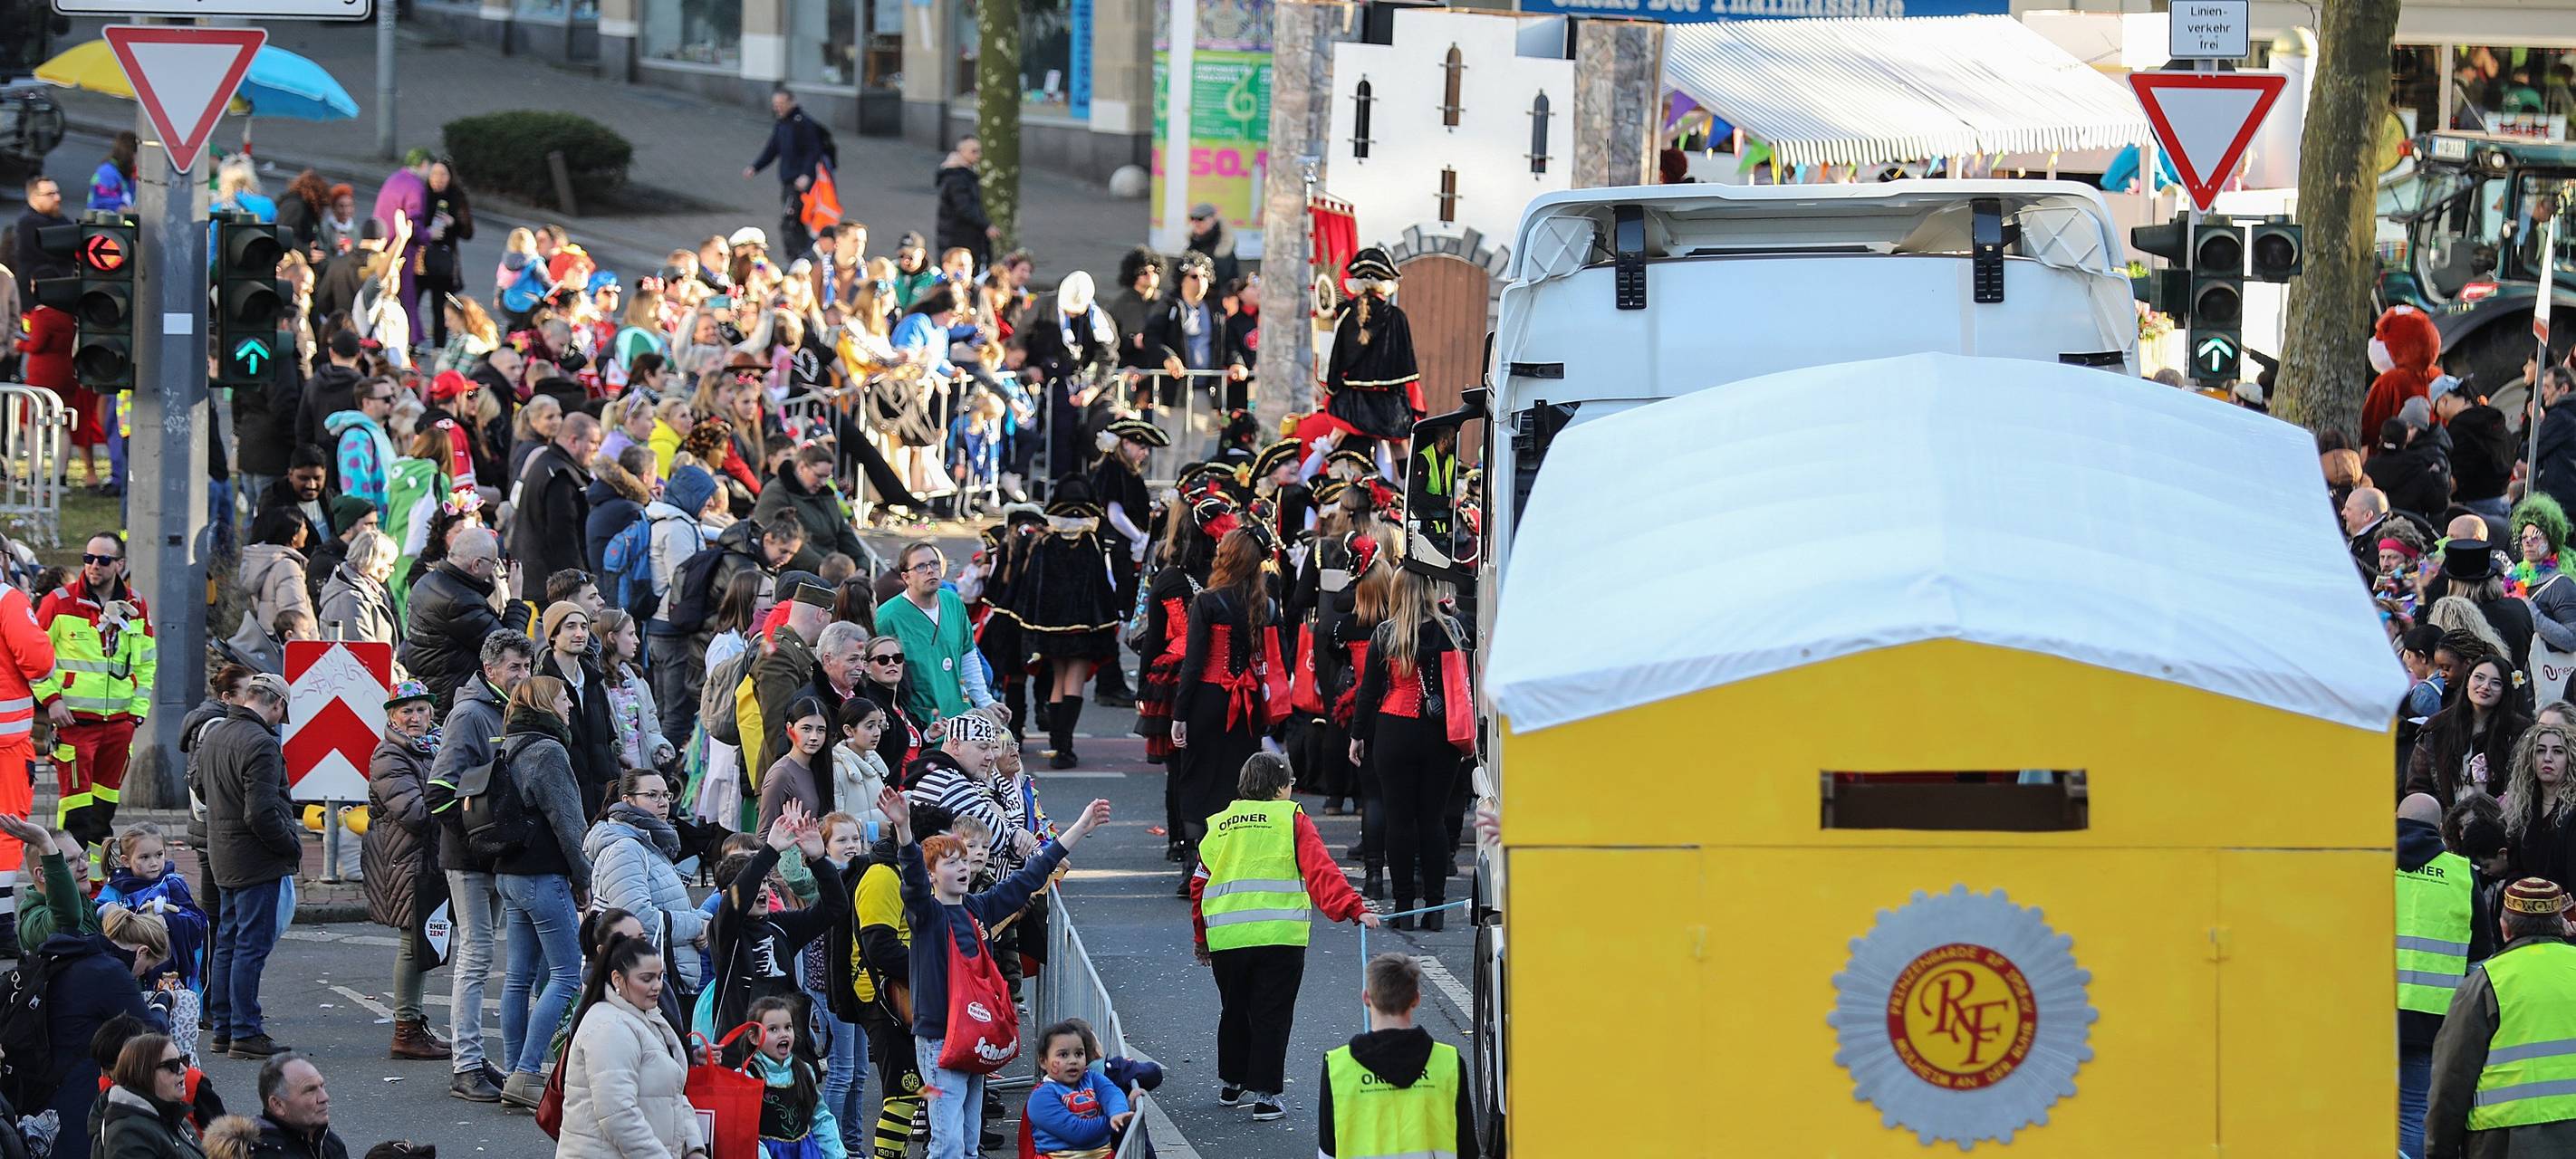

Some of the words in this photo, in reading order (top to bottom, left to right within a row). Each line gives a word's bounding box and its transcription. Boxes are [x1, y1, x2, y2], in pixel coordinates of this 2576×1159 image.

[2190, 6, 2228, 16] Linien-
[2187, 24, 2231, 34] verkehr
[2199, 39, 2219, 50] frei
[1889, 946, 1978, 1015] PRINZENGARDE
[878, 1147, 895, 1158] 1909
